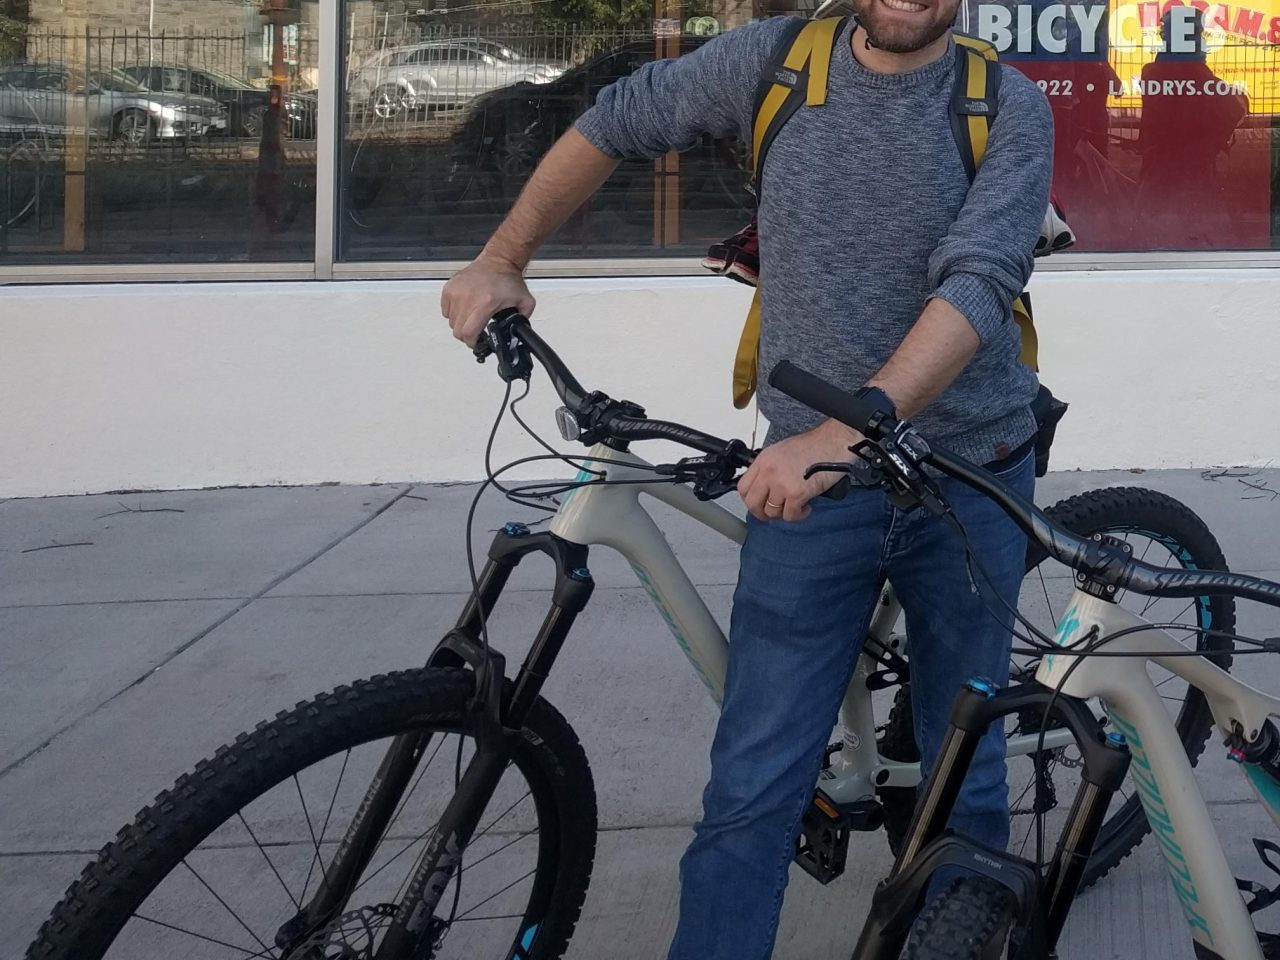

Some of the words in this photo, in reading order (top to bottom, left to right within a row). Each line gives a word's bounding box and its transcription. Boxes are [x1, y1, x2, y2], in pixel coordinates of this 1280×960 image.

[978, 4, 1226, 53] BICYCLES
[1108, 79, 1249, 96] LANDRYS.COM
[901, 442, 918, 460] SLX
[888, 453, 910, 476] SLX
